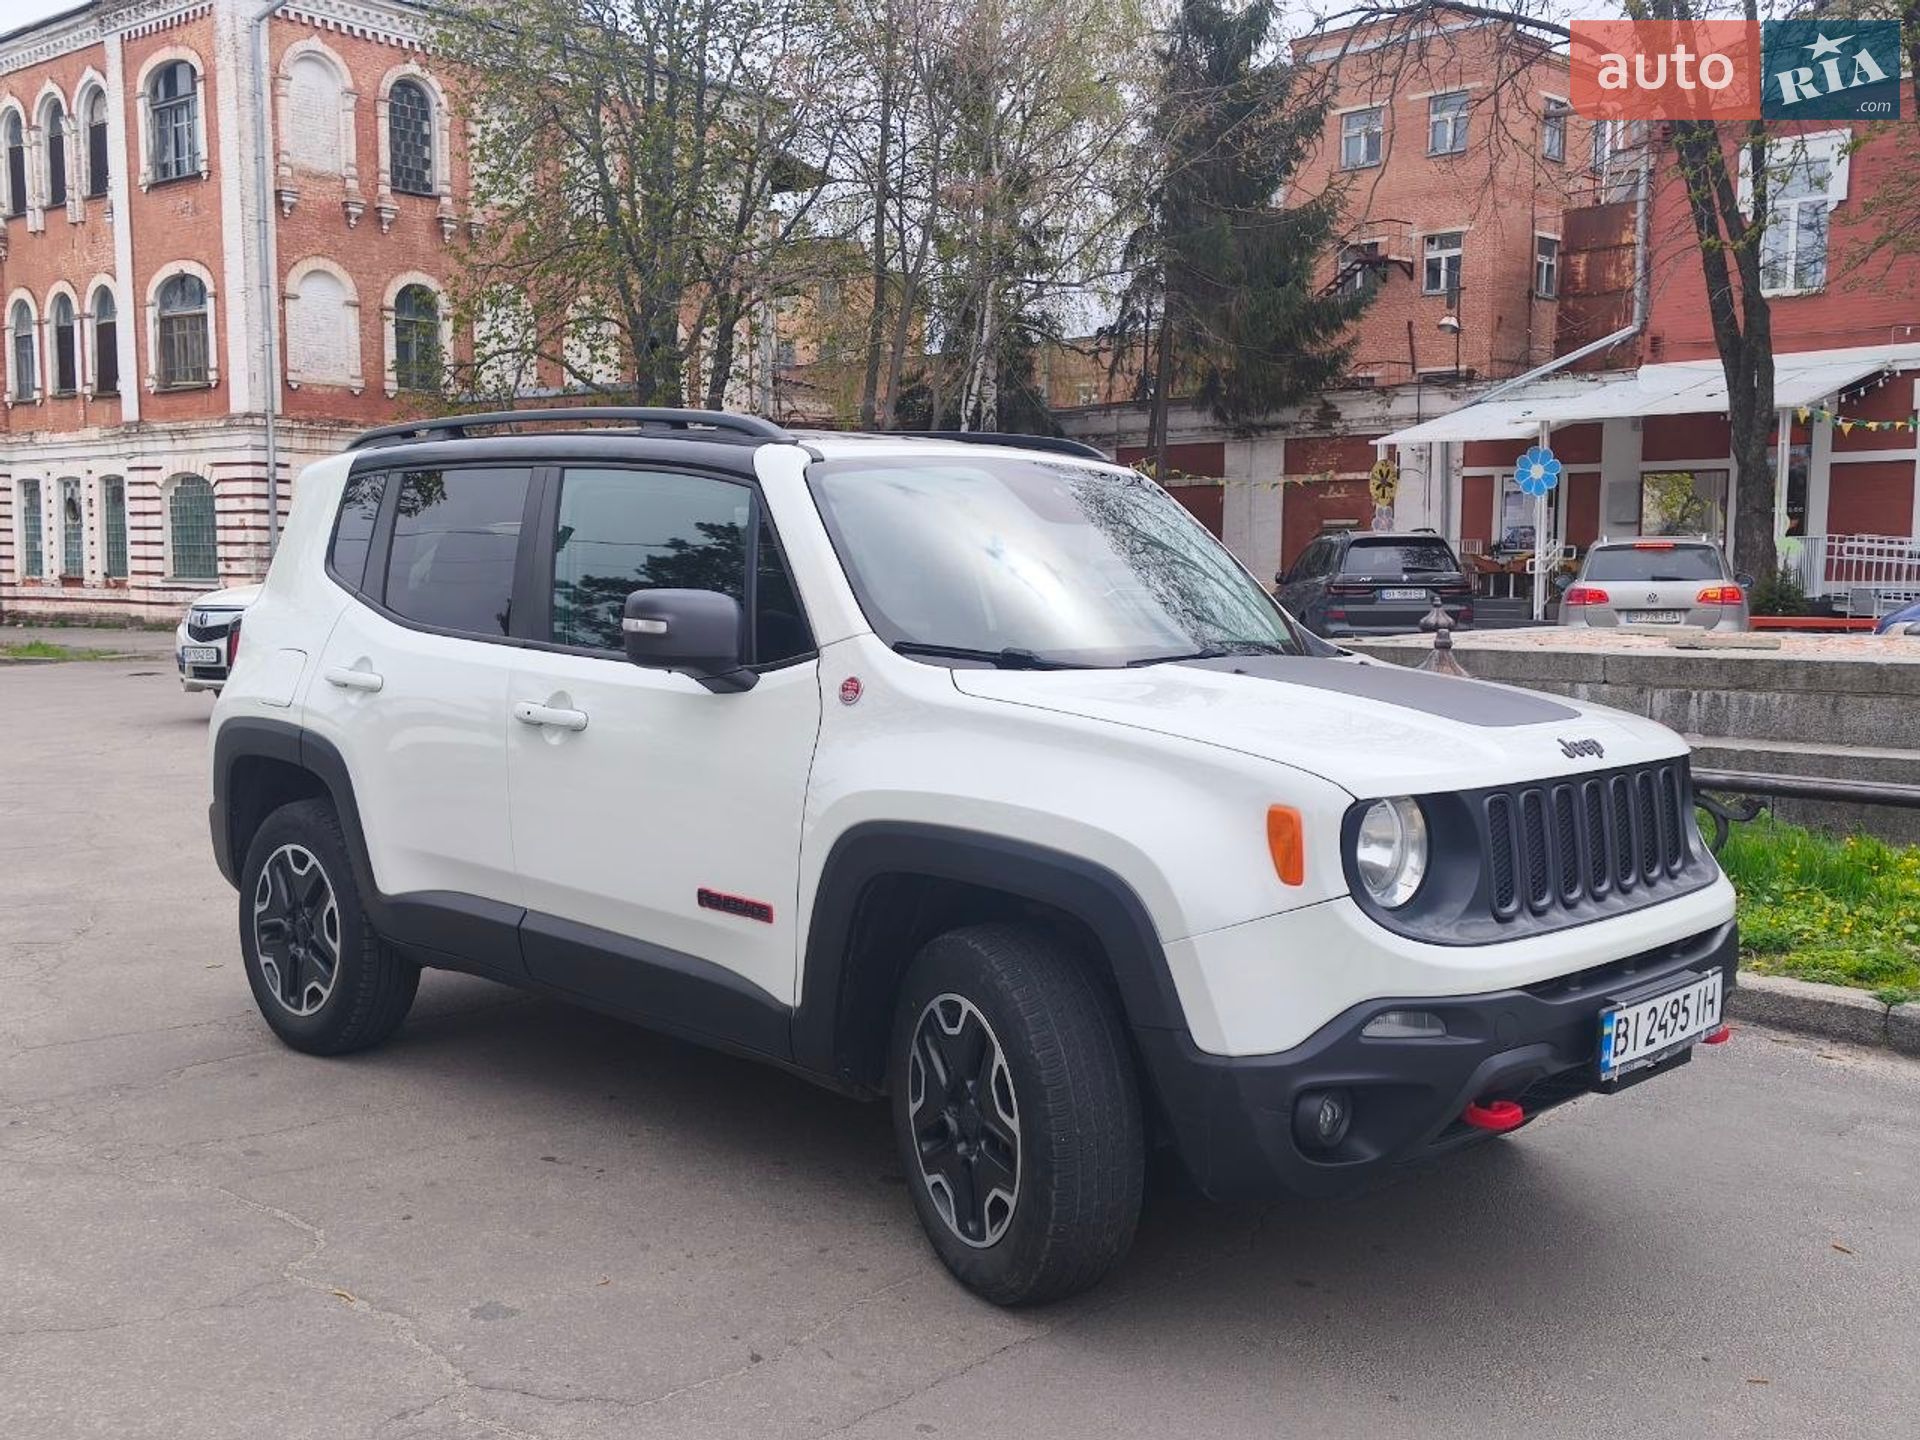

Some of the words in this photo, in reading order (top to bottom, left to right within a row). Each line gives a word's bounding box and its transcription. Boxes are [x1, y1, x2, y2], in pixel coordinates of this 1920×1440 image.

[1557, 738, 1604, 759] Jeep
[1613, 1012, 1640, 1058] BI
[1645, 993, 1691, 1047] 2495
[1695, 983, 1717, 1026] IH
